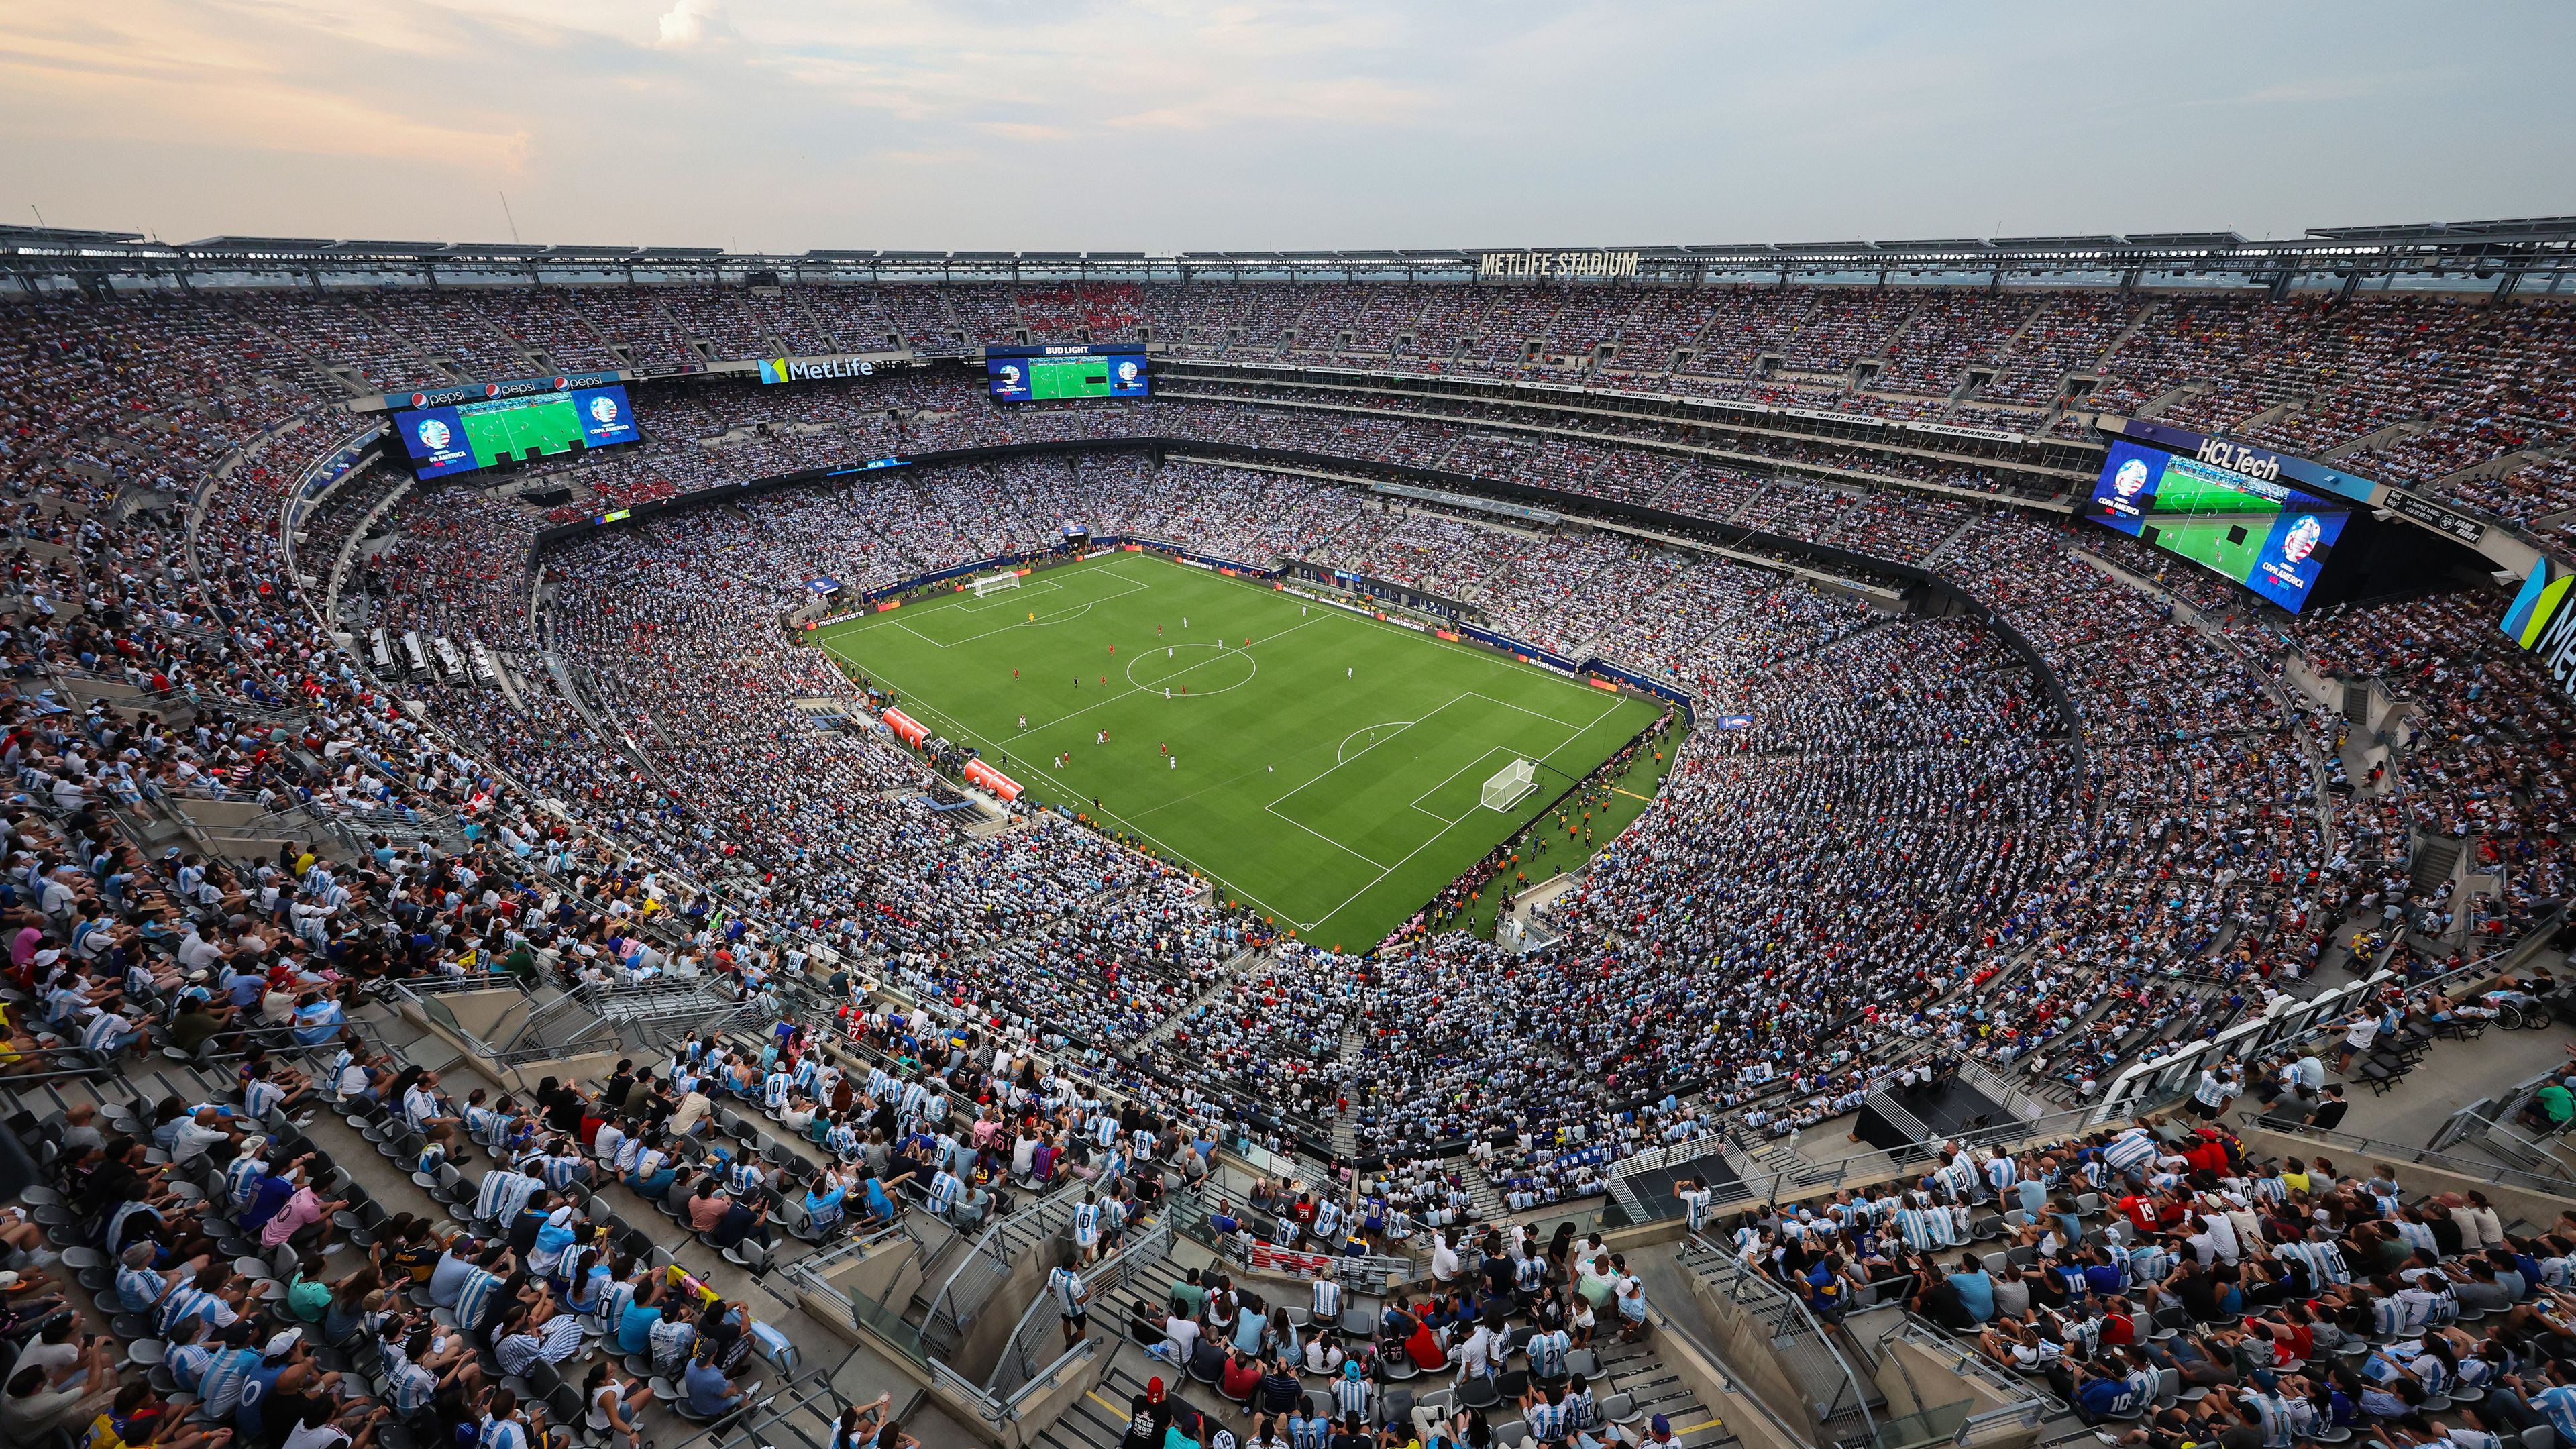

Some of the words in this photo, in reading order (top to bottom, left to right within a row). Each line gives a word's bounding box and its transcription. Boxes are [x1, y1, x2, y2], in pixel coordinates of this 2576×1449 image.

[1481, 253, 1552, 276] METLIFE
[1557, 252, 1638, 276] STADIUM
[789, 358, 873, 380] MetLife
[501, 381, 535, 396] pepsi
[570, 375, 602, 389] pepsi
[429, 389, 465, 405] pepsi
[1816, 413, 1845, 421] MARTY
[1845, 416, 1875, 424] LYONS
[1936, 426, 1962, 434] NICK
[1962, 429, 2009, 440] MANGOLD
[2196, 438, 2279, 480] HCLTech
[1439, 494, 1460, 502] METLIFE
[1461, 498, 1483, 506] STADIUM
[2386, 497, 2400, 508] Help?
[2390, 491, 2402, 500] Need
[2098, 497, 2114, 507] COPA
[2114, 503, 2139, 516] AMERICA
[2455, 519, 2475, 532] FANS
[2456, 529, 2480, 541] FIRST
[1084, 548, 1115, 559] mastercard
[1183, 559, 1212, 570] mastercard
[2262, 562, 2278, 576] COPA
[2278, 570, 2304, 589] AMERICA
[965, 576, 1002, 590] mastercard
[1283, 586, 1315, 600] mastercard
[818, 610, 864, 627] mastercard
[1386, 616, 1425, 632] mastercard
[1529, 658, 1574, 679] mastercard
[769, 1081, 780, 1095] 10
[867, 1077, 874, 1088] 10
[885, 1088, 894, 1100] 10
[994, 1138, 1006, 1151] 10
[1136, 1138, 1146, 1152] 10
[936, 1148, 945, 1162] 10
[1581, 1152, 1589, 1161] 10
[1593, 1149, 1600, 1157] 10
[1570, 1157, 1578, 1165] 10
[2241, 1185, 2253, 1201] 10
[1299, 1210, 1309, 1220] 23
[1368, 1203, 1379, 1219] 10
[1697, 1203, 1710, 1218] 10
[2139, 1203, 2155, 1222] 19
[1078, 1213, 1091, 1229] 10
[1319, 1212, 1330, 1224] 10
[1343, 1220, 1350, 1230] 10
[1389, 1219, 1397, 1230] 10
[1278, 1230, 1287, 1242] 10
[1864, 1236, 1875, 1254] 10
[2328, 1254, 2348, 1274] 10
[2065, 1273, 2086, 1292] 10
[1391, 1351, 1403, 1362] 10
[1546, 1348, 1560, 1365] 21
[2110, 1392, 2131, 1413] 10
[2271, 1411, 2292, 1436] 10
[1220, 1433, 1232, 1447] 10
[1299, 1432, 1316, 1449] 10
